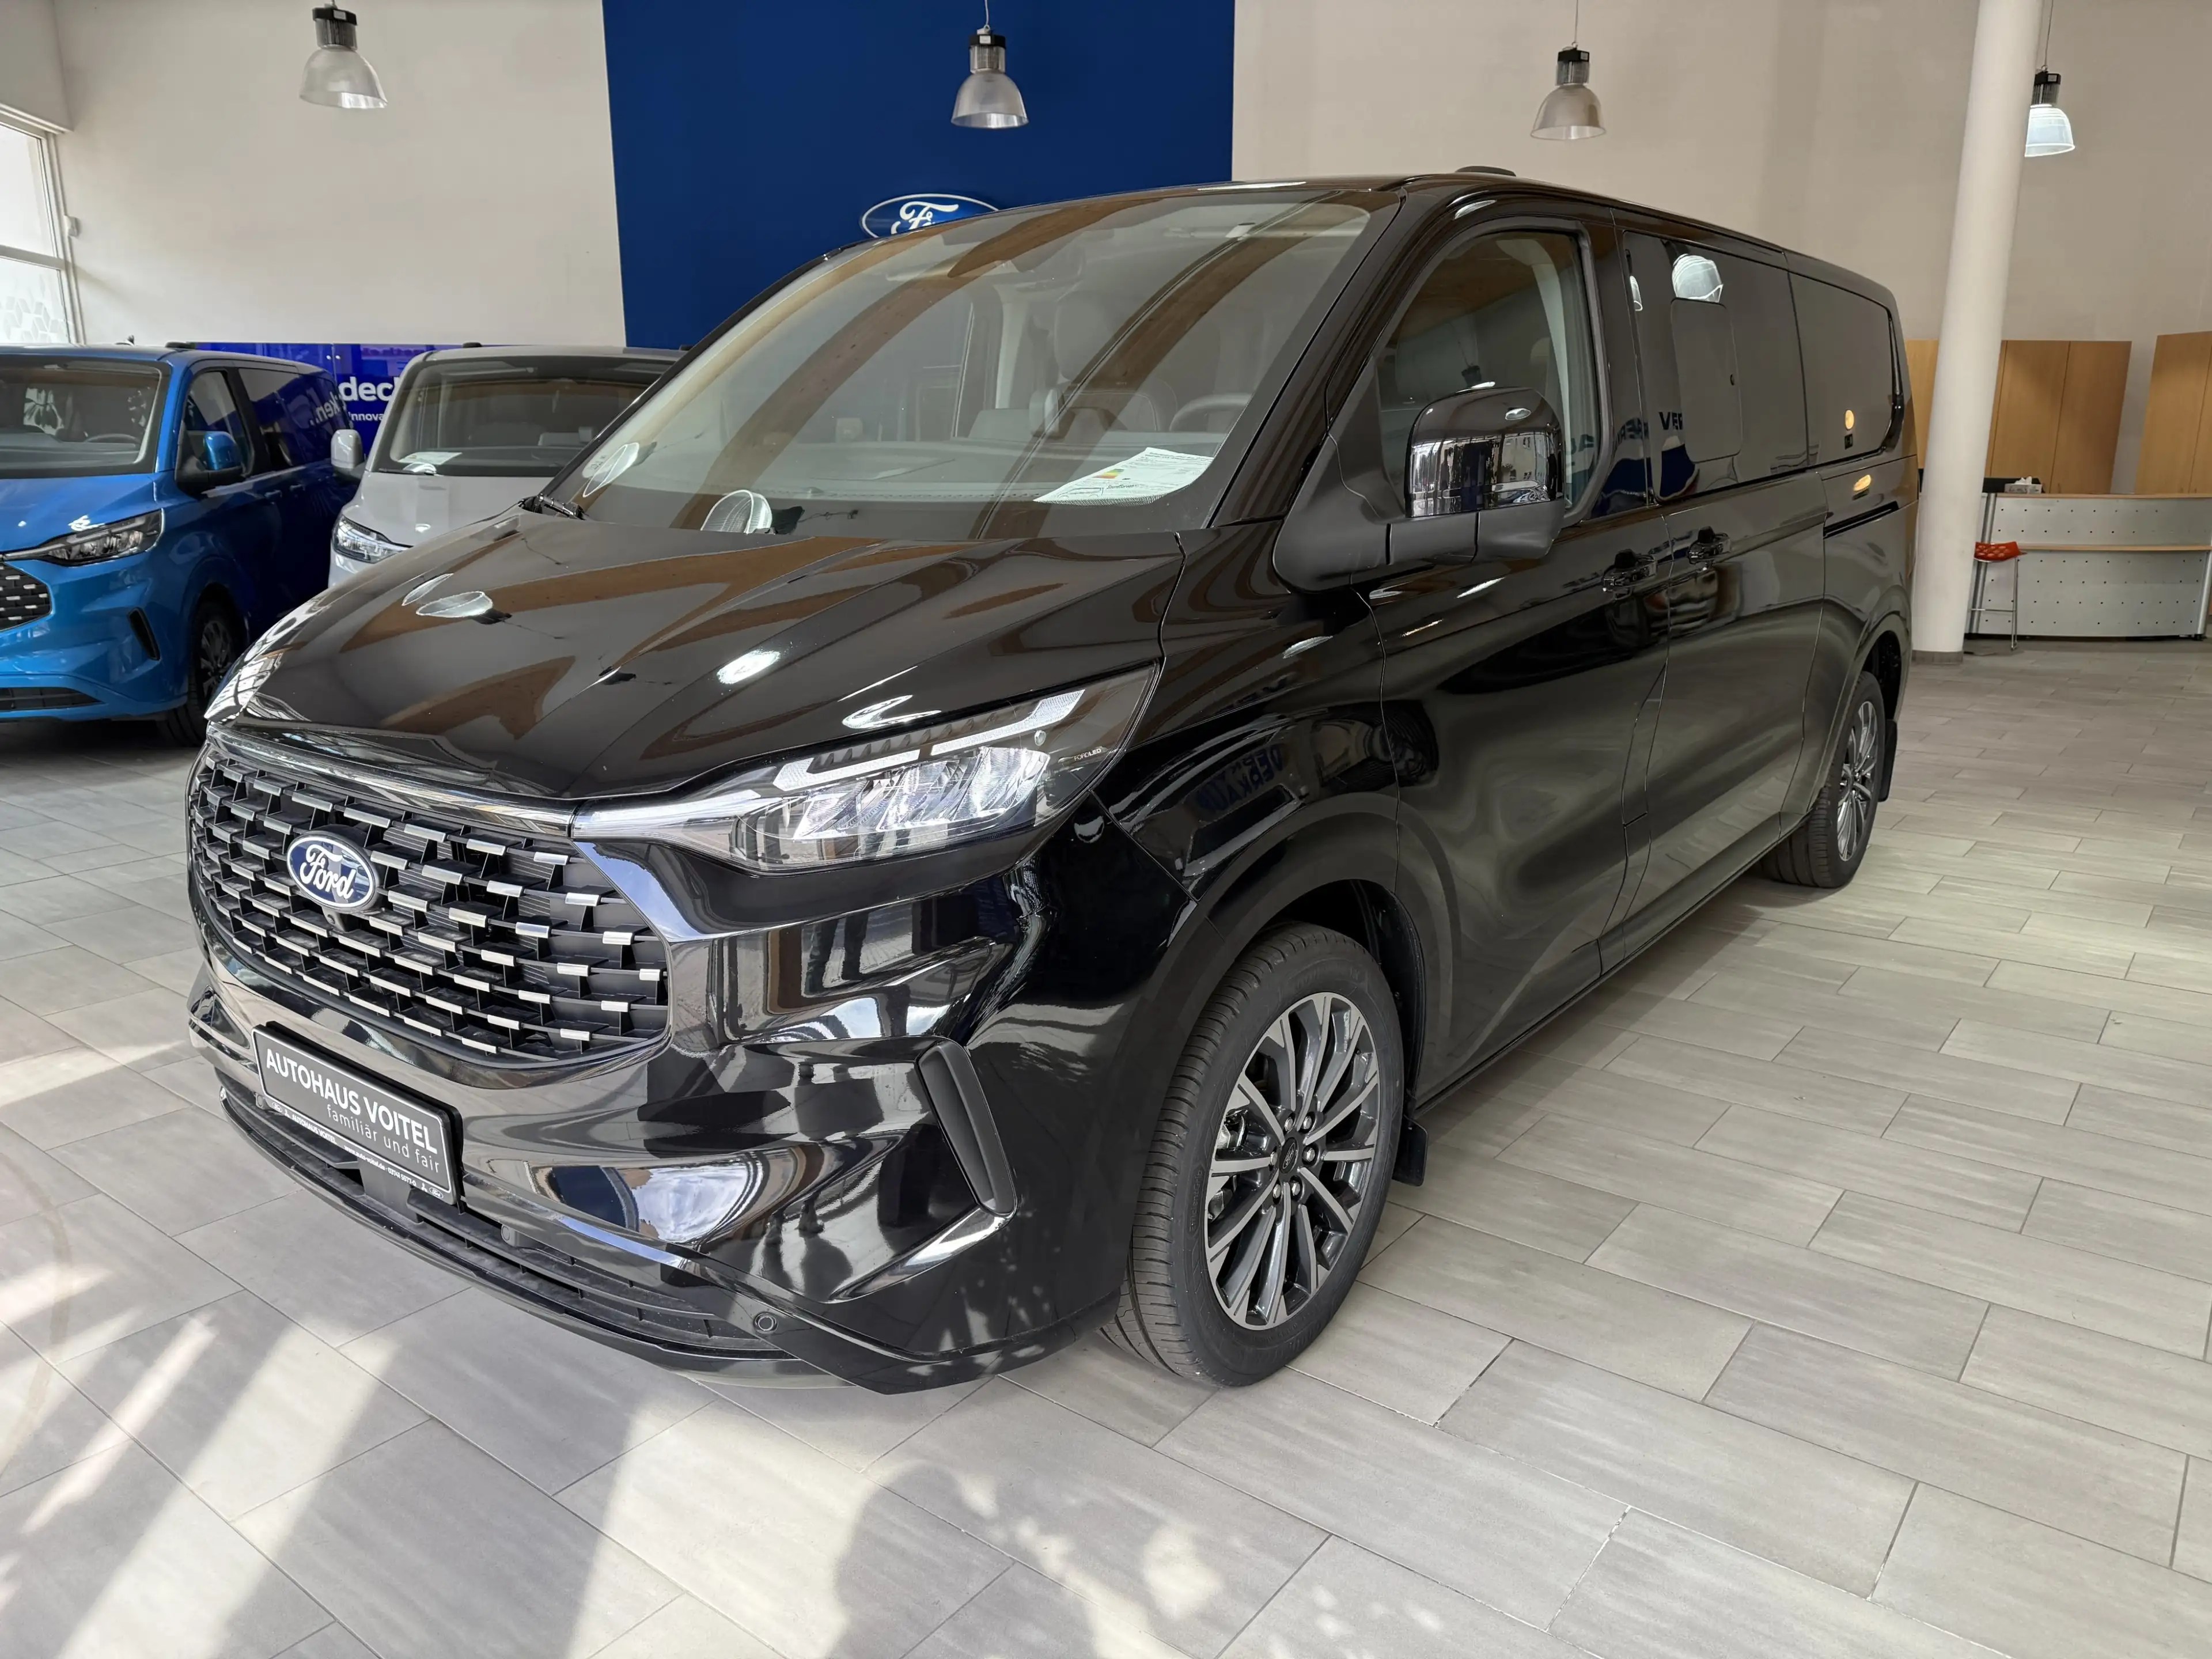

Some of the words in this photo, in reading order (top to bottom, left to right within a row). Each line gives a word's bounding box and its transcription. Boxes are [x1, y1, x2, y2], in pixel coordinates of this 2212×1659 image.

[338, 376, 399, 402] dec
[300, 844, 357, 899] Ford
[266, 1048, 361, 1116] AUTOHAUS
[363, 1096, 438, 1154] VOITEL
[327, 1104, 377, 1142] familiär
[384, 1135, 410, 1158] und
[415, 1148, 440, 1173] fair
